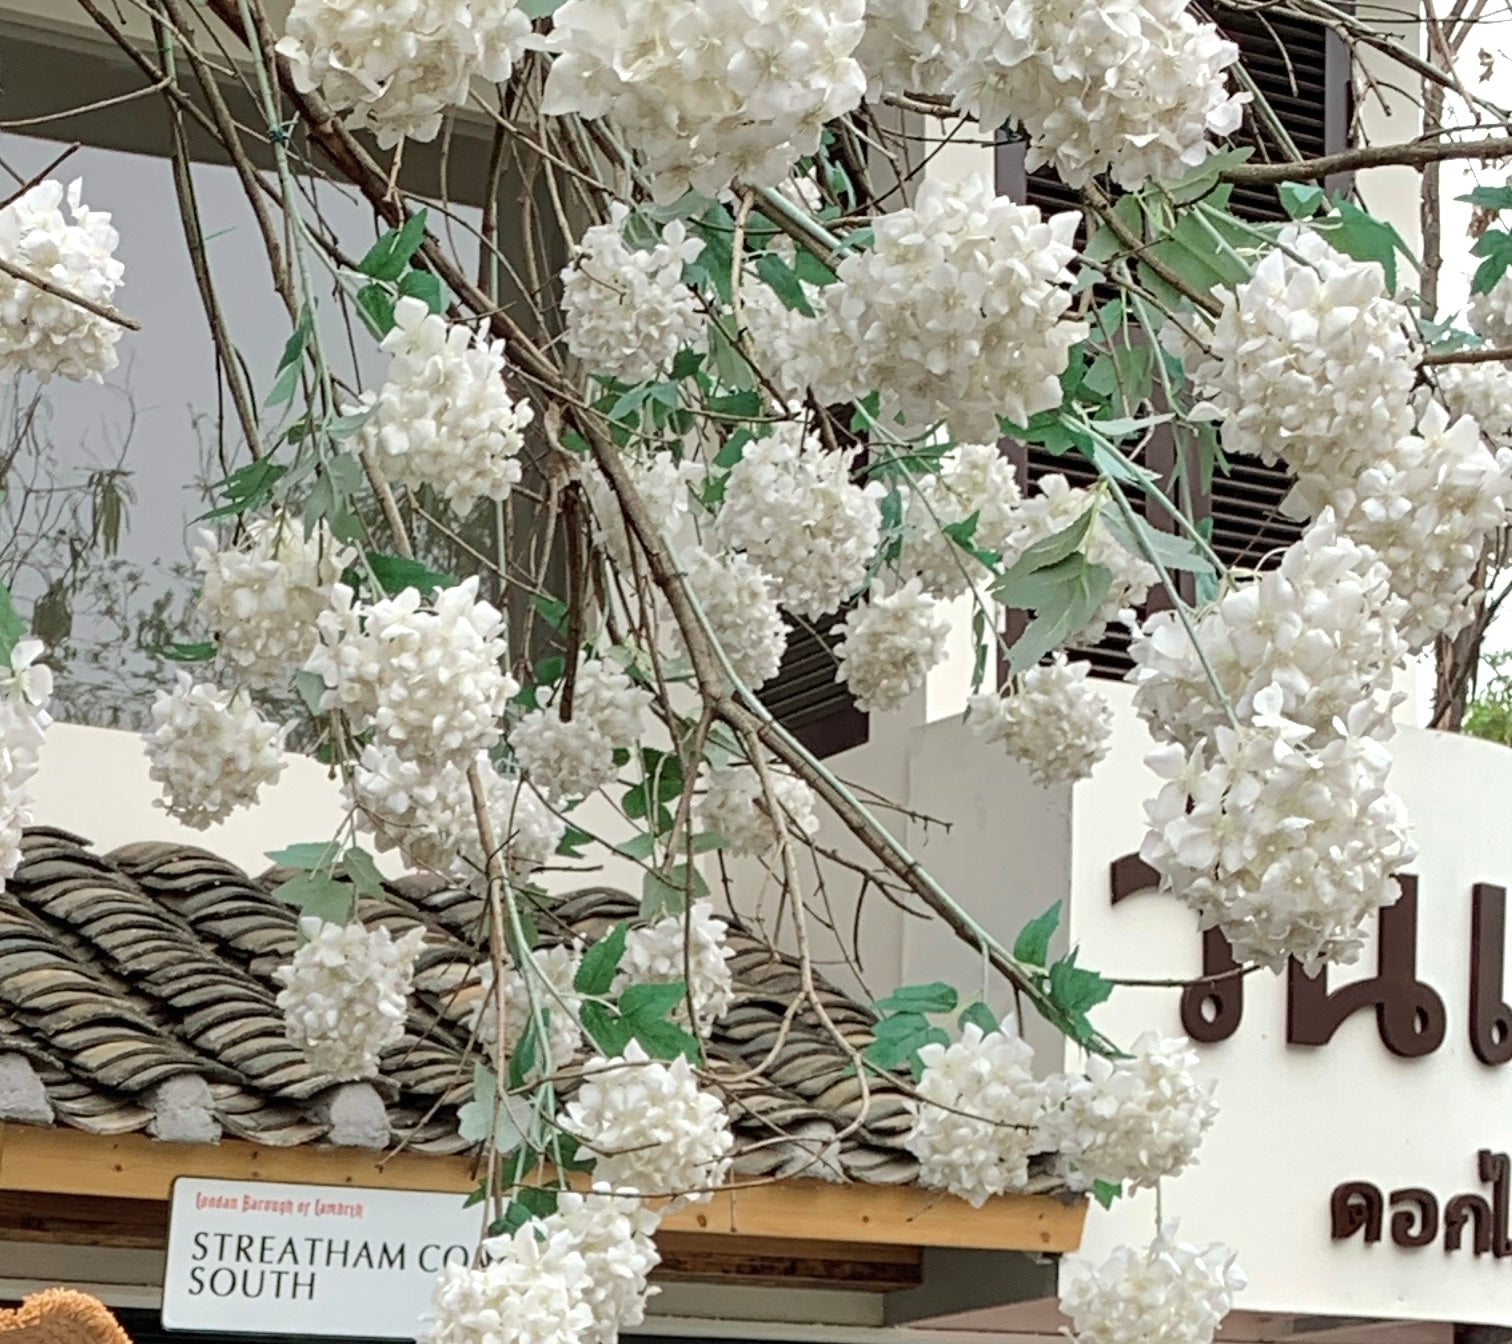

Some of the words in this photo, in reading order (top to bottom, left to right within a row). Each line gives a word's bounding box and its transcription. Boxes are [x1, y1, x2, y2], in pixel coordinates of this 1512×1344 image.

[297, 1201, 311, 1217] of
[191, 1231, 406, 1270] STREATHAM
[187, 1265, 316, 1300] SOUTH
